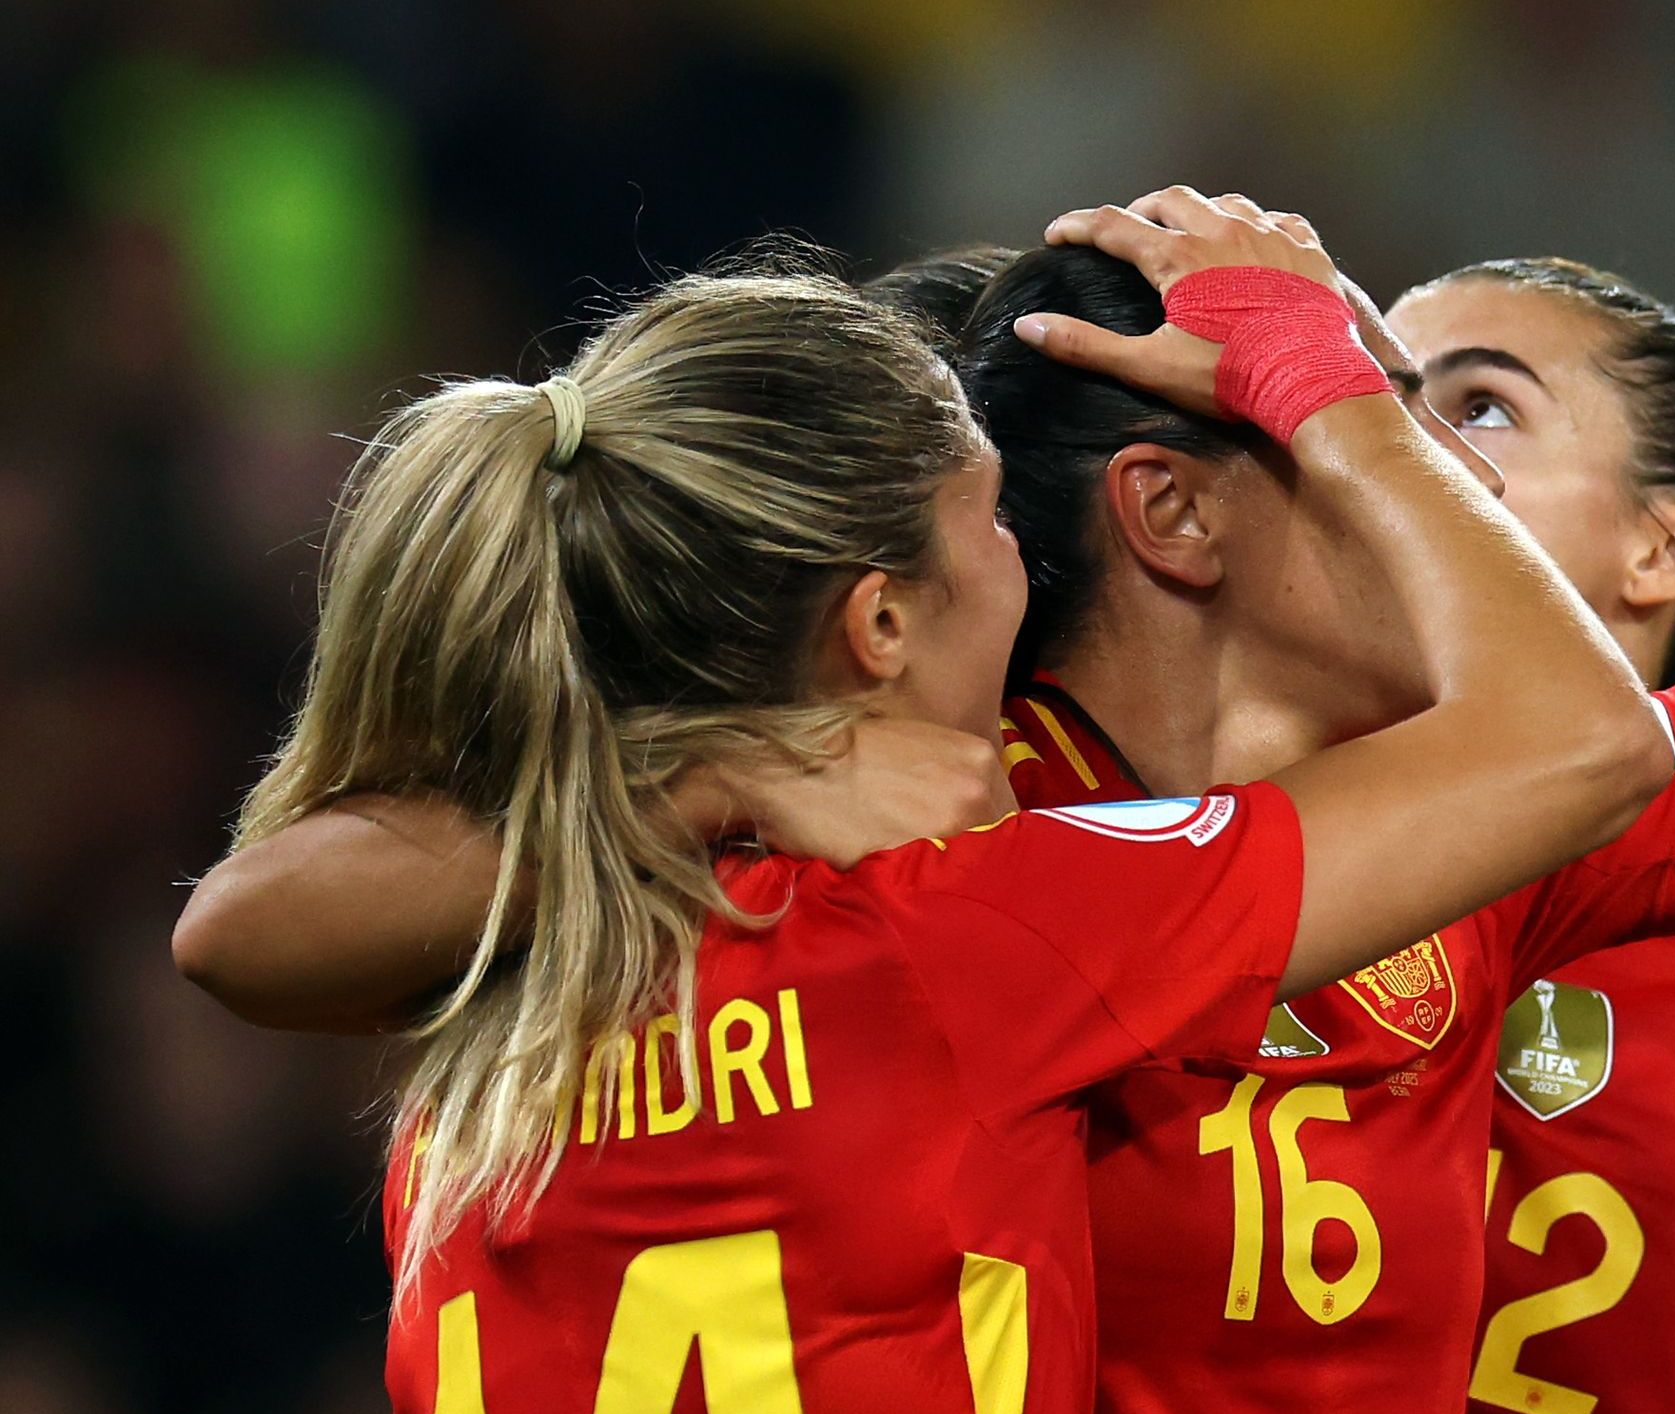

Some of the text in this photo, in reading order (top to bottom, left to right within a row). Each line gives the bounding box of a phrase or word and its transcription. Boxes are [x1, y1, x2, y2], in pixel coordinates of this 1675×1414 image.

[1259, 1046, 1299, 1057] IFA
[1520, 1049, 1576, 1077] FIFA
[1528, 1079, 1562, 1095] 2023
[1199, 1073, 1382, 1325] 16
